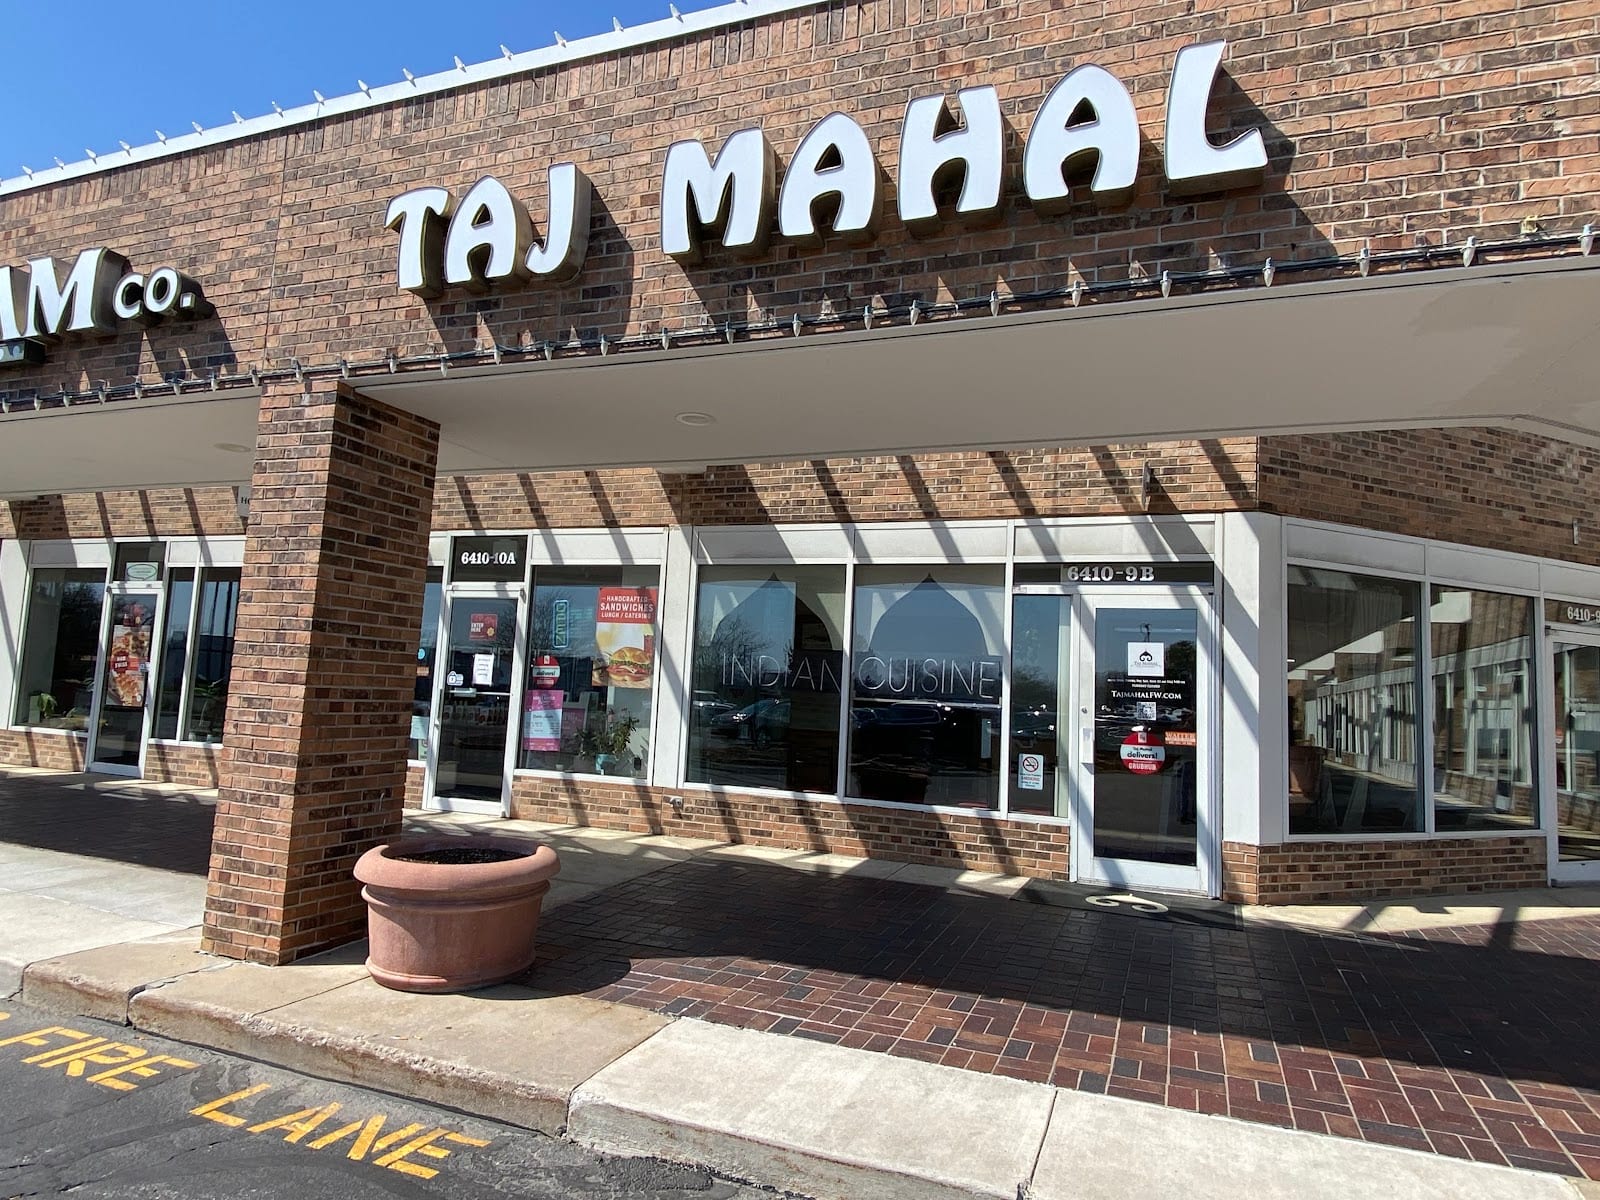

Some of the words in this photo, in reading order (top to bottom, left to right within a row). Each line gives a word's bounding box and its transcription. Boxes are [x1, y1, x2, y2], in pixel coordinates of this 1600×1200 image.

[385, 163, 584, 293] TAJ
[661, 40, 1268, 256] MAHAL
[461, 551, 516, 564] 6410-10A
[1067, 566, 1155, 581] 6410-9B
[600, 602, 654, 612] SANDWICHES
[606, 595, 648, 603] HANDCRAFTED
[721, 652, 842, 693] INDIAN
[858, 656, 998, 699] CUISINE
[0, 1026, 201, 1091] FIRE
[189, 1083, 492, 1179] LANE
